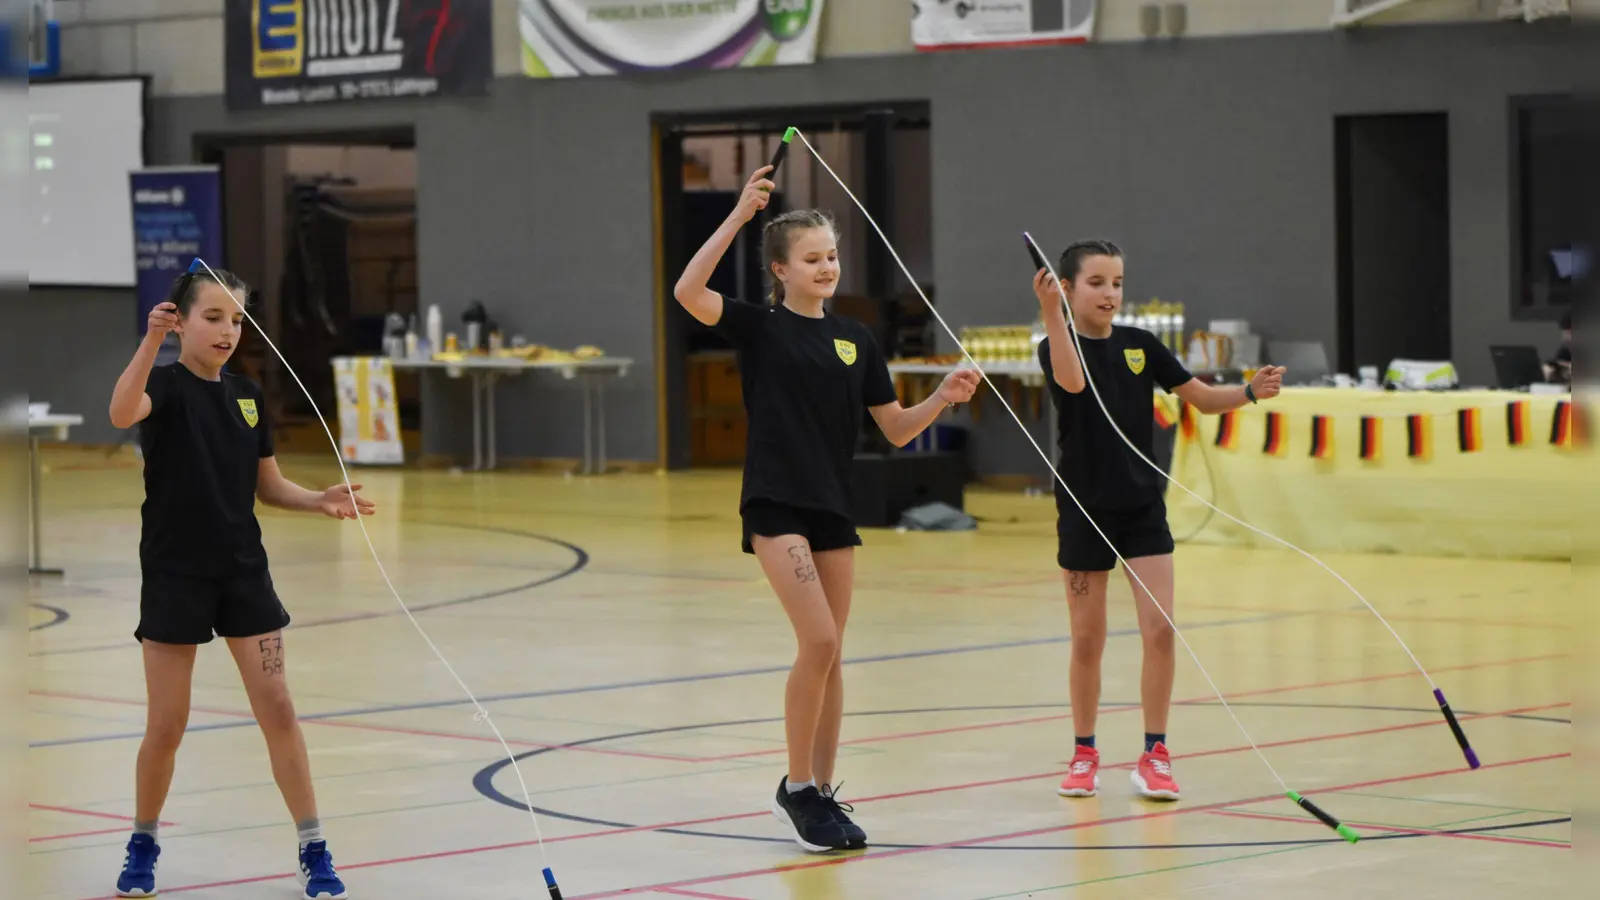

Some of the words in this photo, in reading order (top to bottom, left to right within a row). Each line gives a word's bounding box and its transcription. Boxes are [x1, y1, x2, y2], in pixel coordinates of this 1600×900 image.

[787, 545, 812, 564] 57
[795, 564, 816, 583] 58
[1070, 581, 1089, 597] 58
[259, 637, 282, 659] 57
[262, 657, 282, 678] 58
